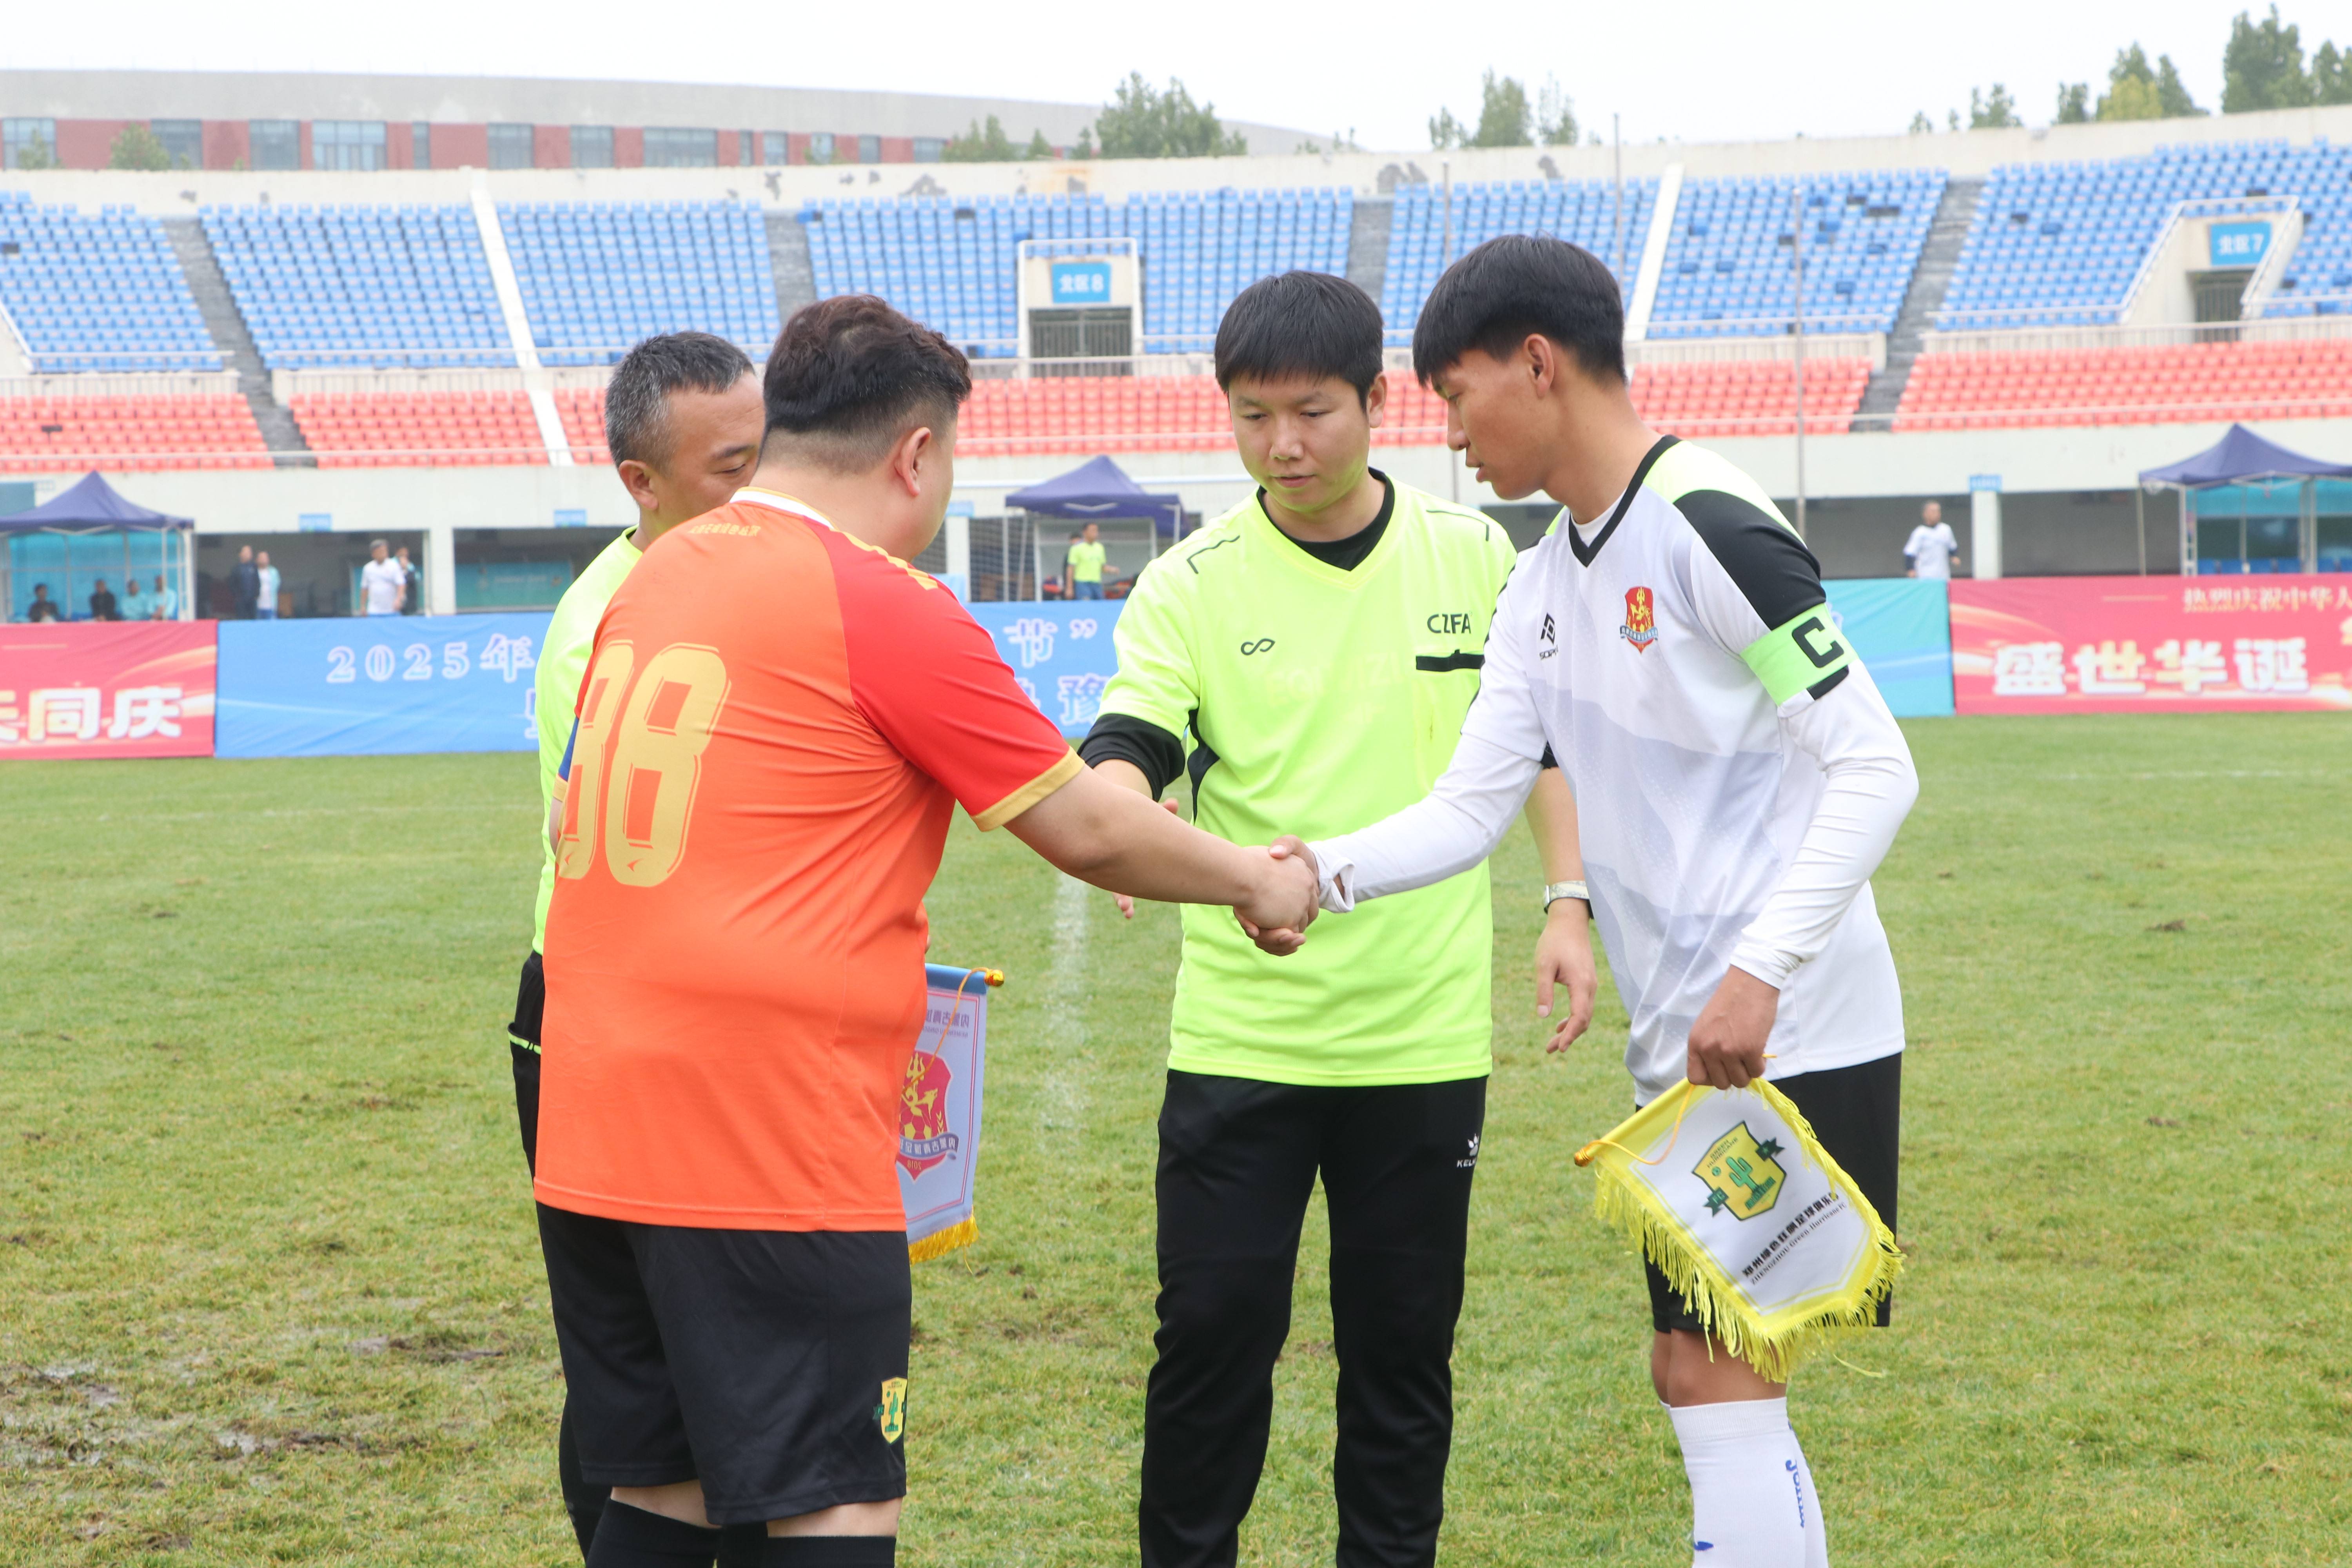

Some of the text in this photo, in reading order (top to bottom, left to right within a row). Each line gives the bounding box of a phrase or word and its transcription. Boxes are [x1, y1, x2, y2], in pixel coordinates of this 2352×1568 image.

[326, 633, 535, 683] 2025年
[1791, 616, 1844, 668] C
[1993, 637, 2310, 696] 盛世华诞
[0, 685, 183, 742] 同庆
[1750, 1246, 1790, 1285] ZHENGZHOU
